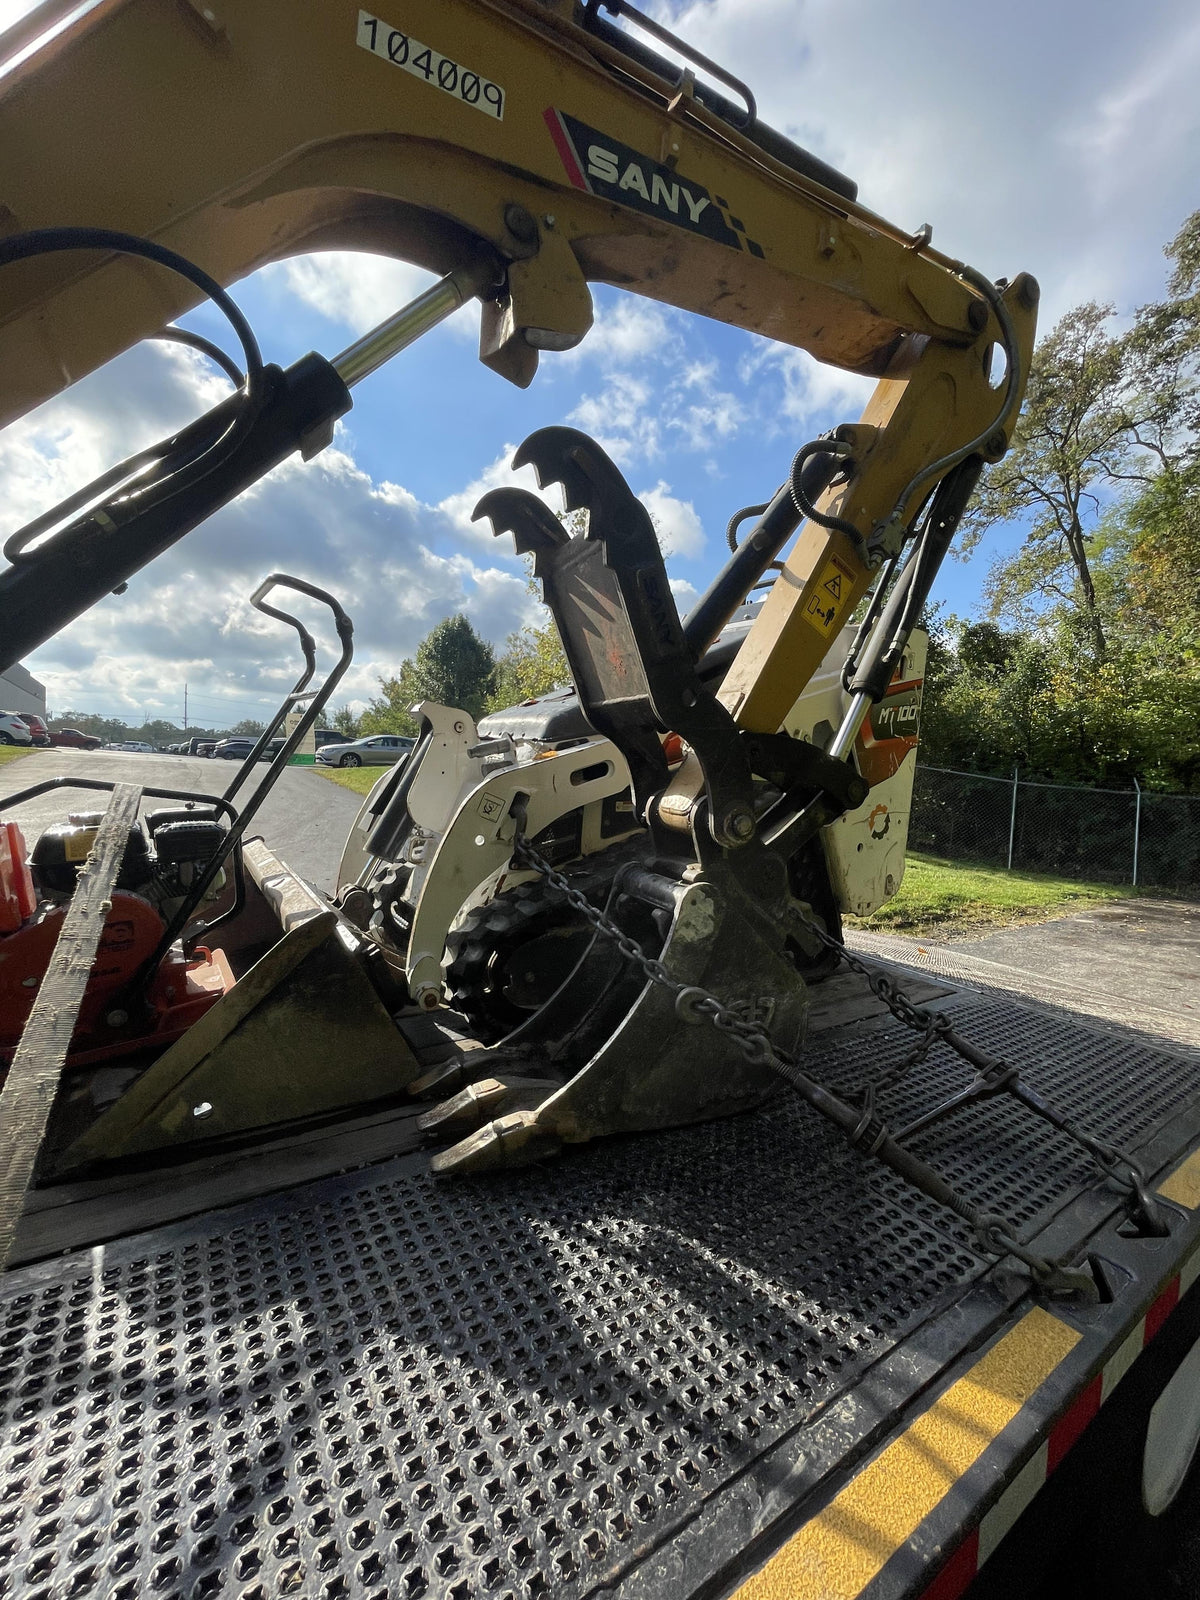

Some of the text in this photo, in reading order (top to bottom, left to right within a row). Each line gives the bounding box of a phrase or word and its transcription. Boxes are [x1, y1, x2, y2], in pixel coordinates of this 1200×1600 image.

[363, 19, 503, 117] 104009
[587, 144, 711, 224] SANY
[878, 704, 917, 724] MT100
